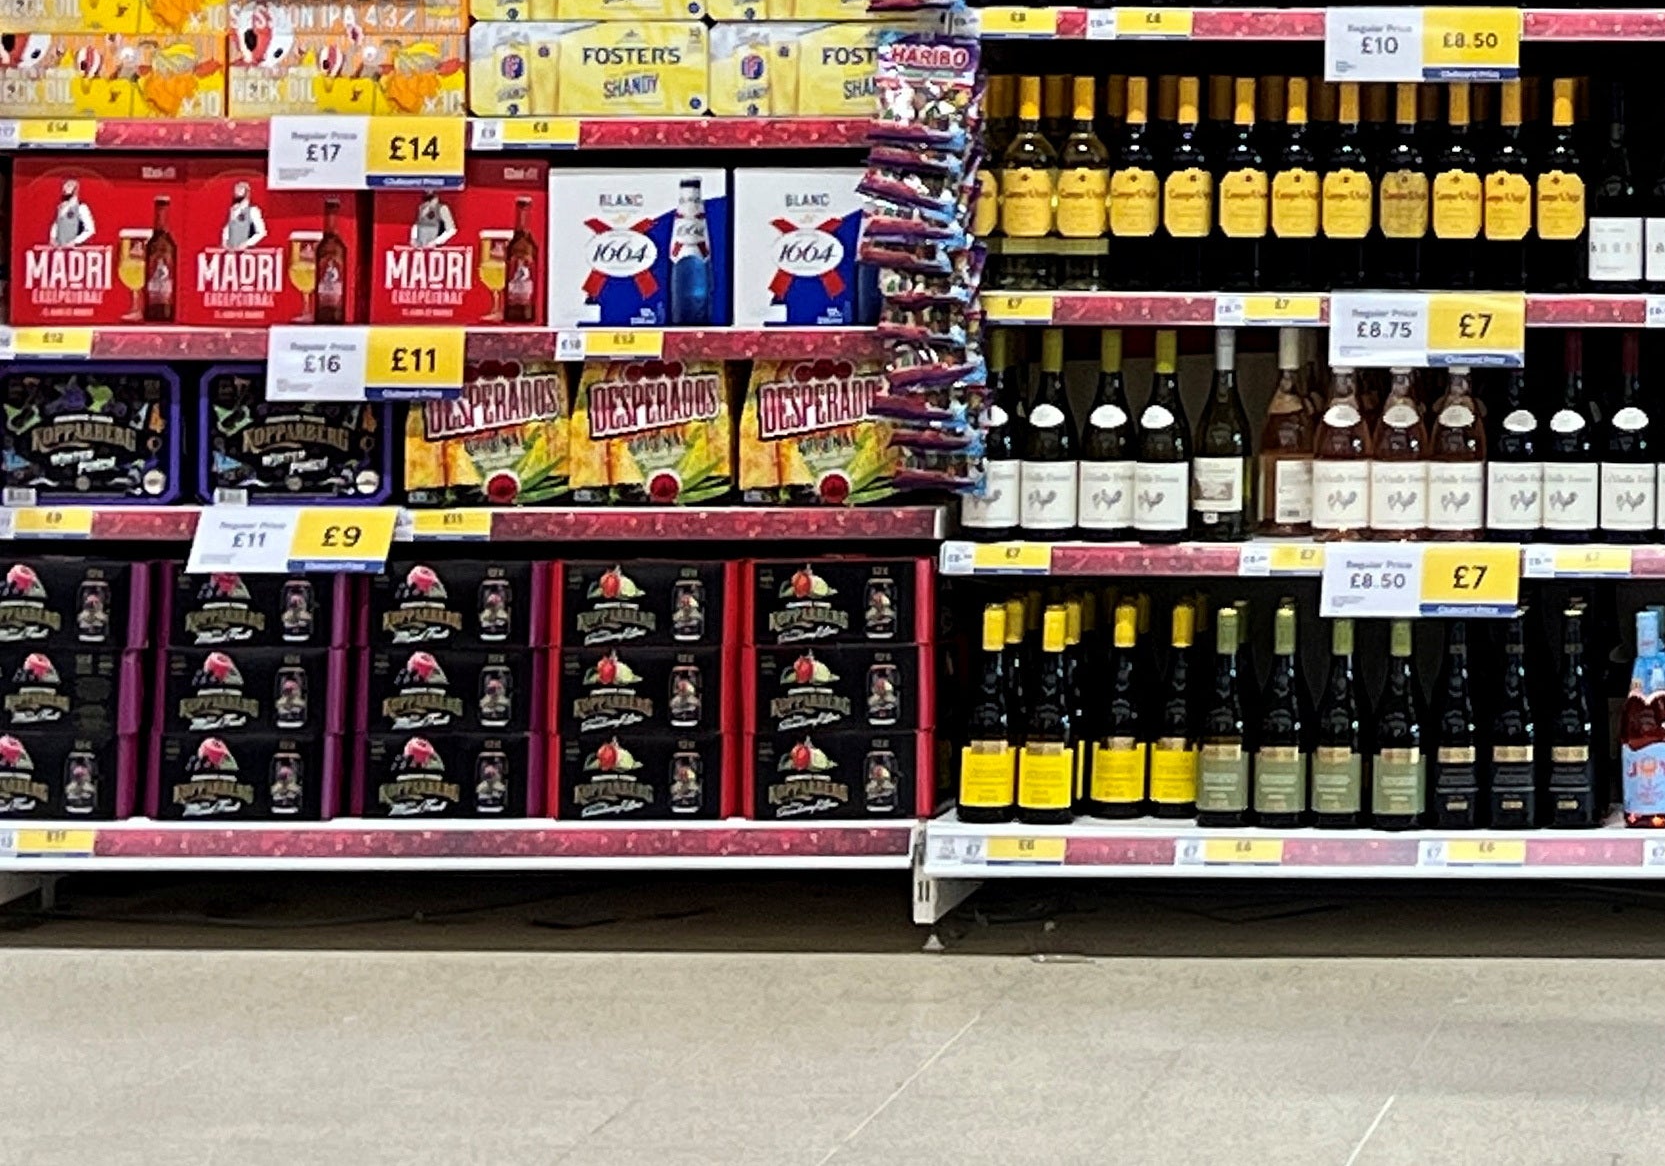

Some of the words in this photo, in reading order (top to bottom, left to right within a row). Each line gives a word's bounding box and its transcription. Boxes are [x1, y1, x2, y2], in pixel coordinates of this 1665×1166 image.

[1360, 37, 1399, 54] £10
[1442, 32, 1498, 49] £8.50
[582, 46, 681, 66] FOSTER'S
[890, 44, 969, 67] HARIBO
[603, 74, 660, 100] SHANDY
[305, 144, 343, 162] £17
[388, 136, 441, 162] £14
[599, 192, 644, 207] BLANC
[785, 192, 830, 207] BLANC
[592, 243, 651, 263] 1664
[778, 243, 838, 263] 1664
[1356, 321, 1413, 339] £8.75
[1458, 314, 1493, 339] £7
[303, 355, 341, 372] £16
[391, 347, 437, 373] £11
[425, 379, 558, 432] DESPERADOS
[591, 379, 718, 432] DESPERADOS
[762, 380, 877, 433] DESPERADO
[32, 421, 136, 453] KOPPARBERG
[243, 421, 349, 453] KOPPARBERG
[231, 532, 266, 548] £11
[321, 526, 361, 548] £9
[1349, 572, 1406, 589] £8.50
[1453, 565, 1488, 590] £7
